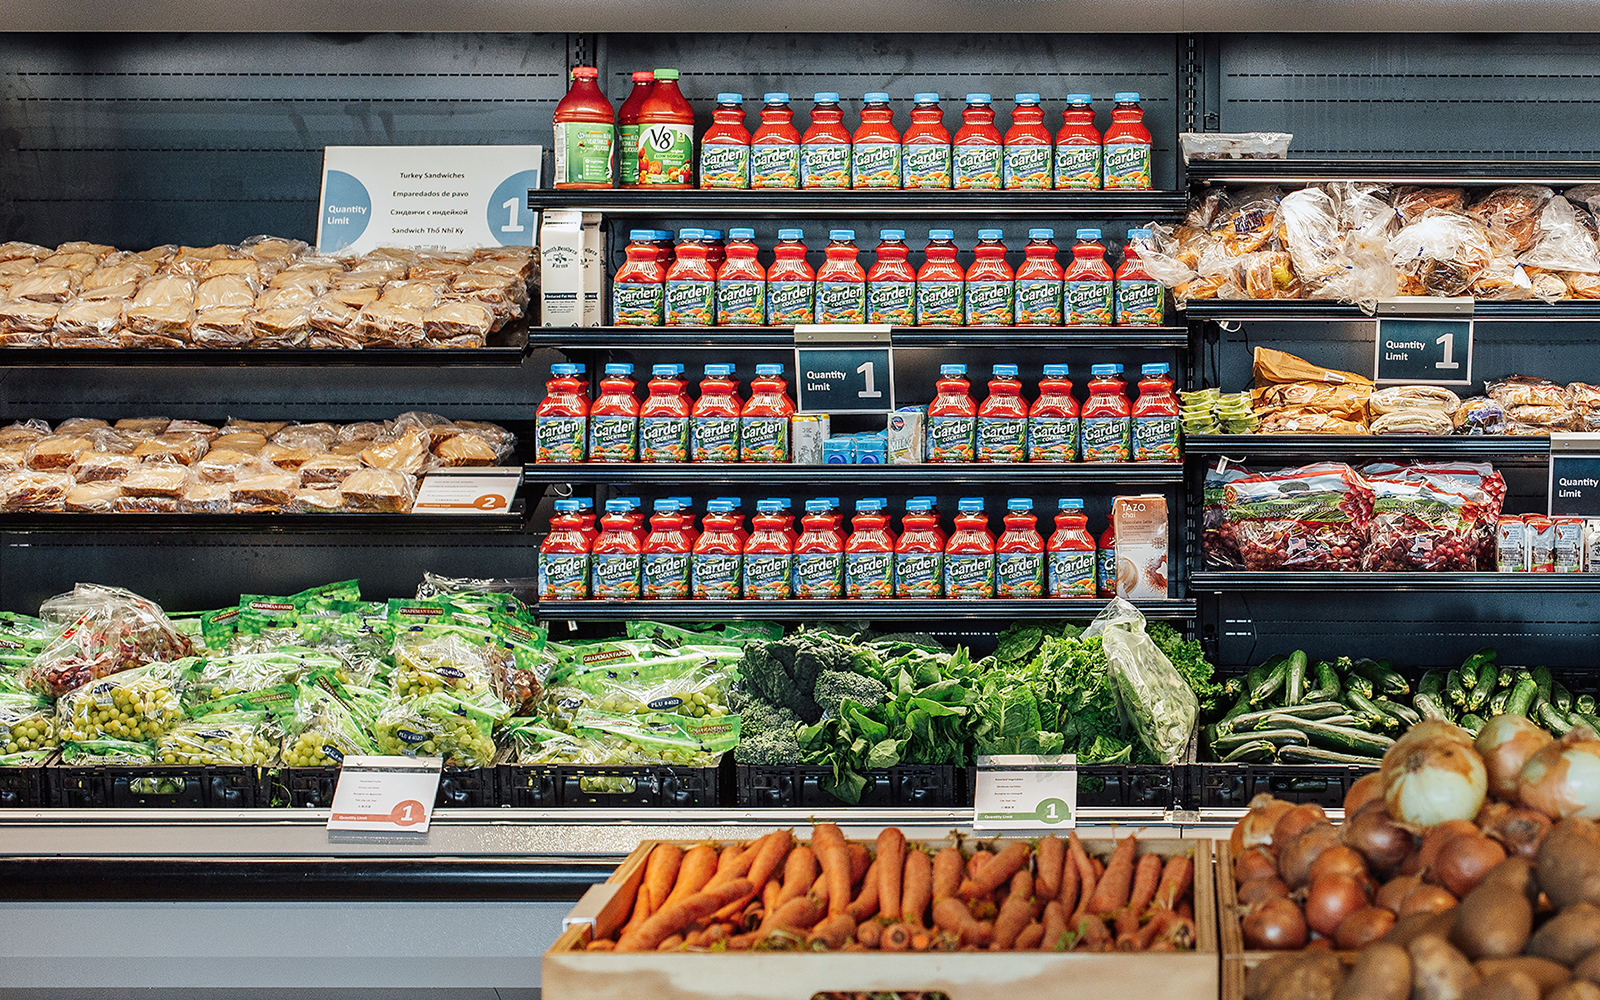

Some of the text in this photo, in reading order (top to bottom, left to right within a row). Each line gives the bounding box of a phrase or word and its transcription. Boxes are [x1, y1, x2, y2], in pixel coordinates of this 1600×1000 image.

[650, 126, 671, 149] V8
[702, 148, 743, 166] Garden
[752, 149, 794, 166] Garden
[806, 148, 848, 167] Garden
[854, 148, 896, 166] Garden
[907, 148, 948, 166] Garden
[958, 149, 999, 168] Garden
[1009, 149, 1050, 168] Garden
[1058, 148, 1099, 167] Garden
[1106, 148, 1147, 166] Garden
[328, 205, 367, 216] Quantity
[501, 197, 524, 232] 1
[328, 216, 350, 225] Limit
[617, 288, 659, 305] Garden
[668, 286, 710, 303] Garden
[718, 286, 760, 303] Garden
[771, 286, 814, 304] Garden
[821, 286, 863, 304] Garden
[870, 286, 912, 304] Garden
[920, 286, 961, 304] Garden
[969, 286, 1010, 304] Garden
[1019, 284, 1062, 303] Garden
[1068, 285, 1110, 303] Garden
[1119, 285, 1160, 303] Garden
[1386, 340, 1426, 351] Quantity
[1435, 332, 1459, 369] 1
[1386, 351, 1408, 361] Limit
[806, 370, 846, 380] Quantity
[856, 362, 882, 398] 1
[807, 383, 830, 391] Limit
[537, 422, 578, 439] Garden
[594, 421, 634, 438] Garden
[643, 422, 685, 439] Garden
[695, 422, 737, 439] Garden
[742, 422, 782, 438] Garden
[932, 422, 973, 439] Garden
[982, 422, 1023, 439] Garden
[1032, 422, 1074, 439] Garden
[1085, 422, 1126, 439] Garden
[1136, 421, 1177, 438] Garden
[1559, 478, 1599, 488] Quantity
[482, 497, 496, 508] 2
[1558, 490, 1582, 498] Limit
[545, 558, 587, 576] Garden
[598, 558, 639, 576] Garden
[645, 557, 687, 576] Garden
[696, 558, 738, 576] Garden
[747, 558, 788, 576] Garden
[799, 557, 839, 576] Garden
[849, 556, 889, 574] Garden
[897, 556, 938, 574] Garden
[950, 558, 991, 575] Garden
[999, 557, 1040, 574] Garden
[1055, 556, 1095, 573] Garden
[401, 805, 413, 821] 1
[1046, 803, 1058, 818] 1
